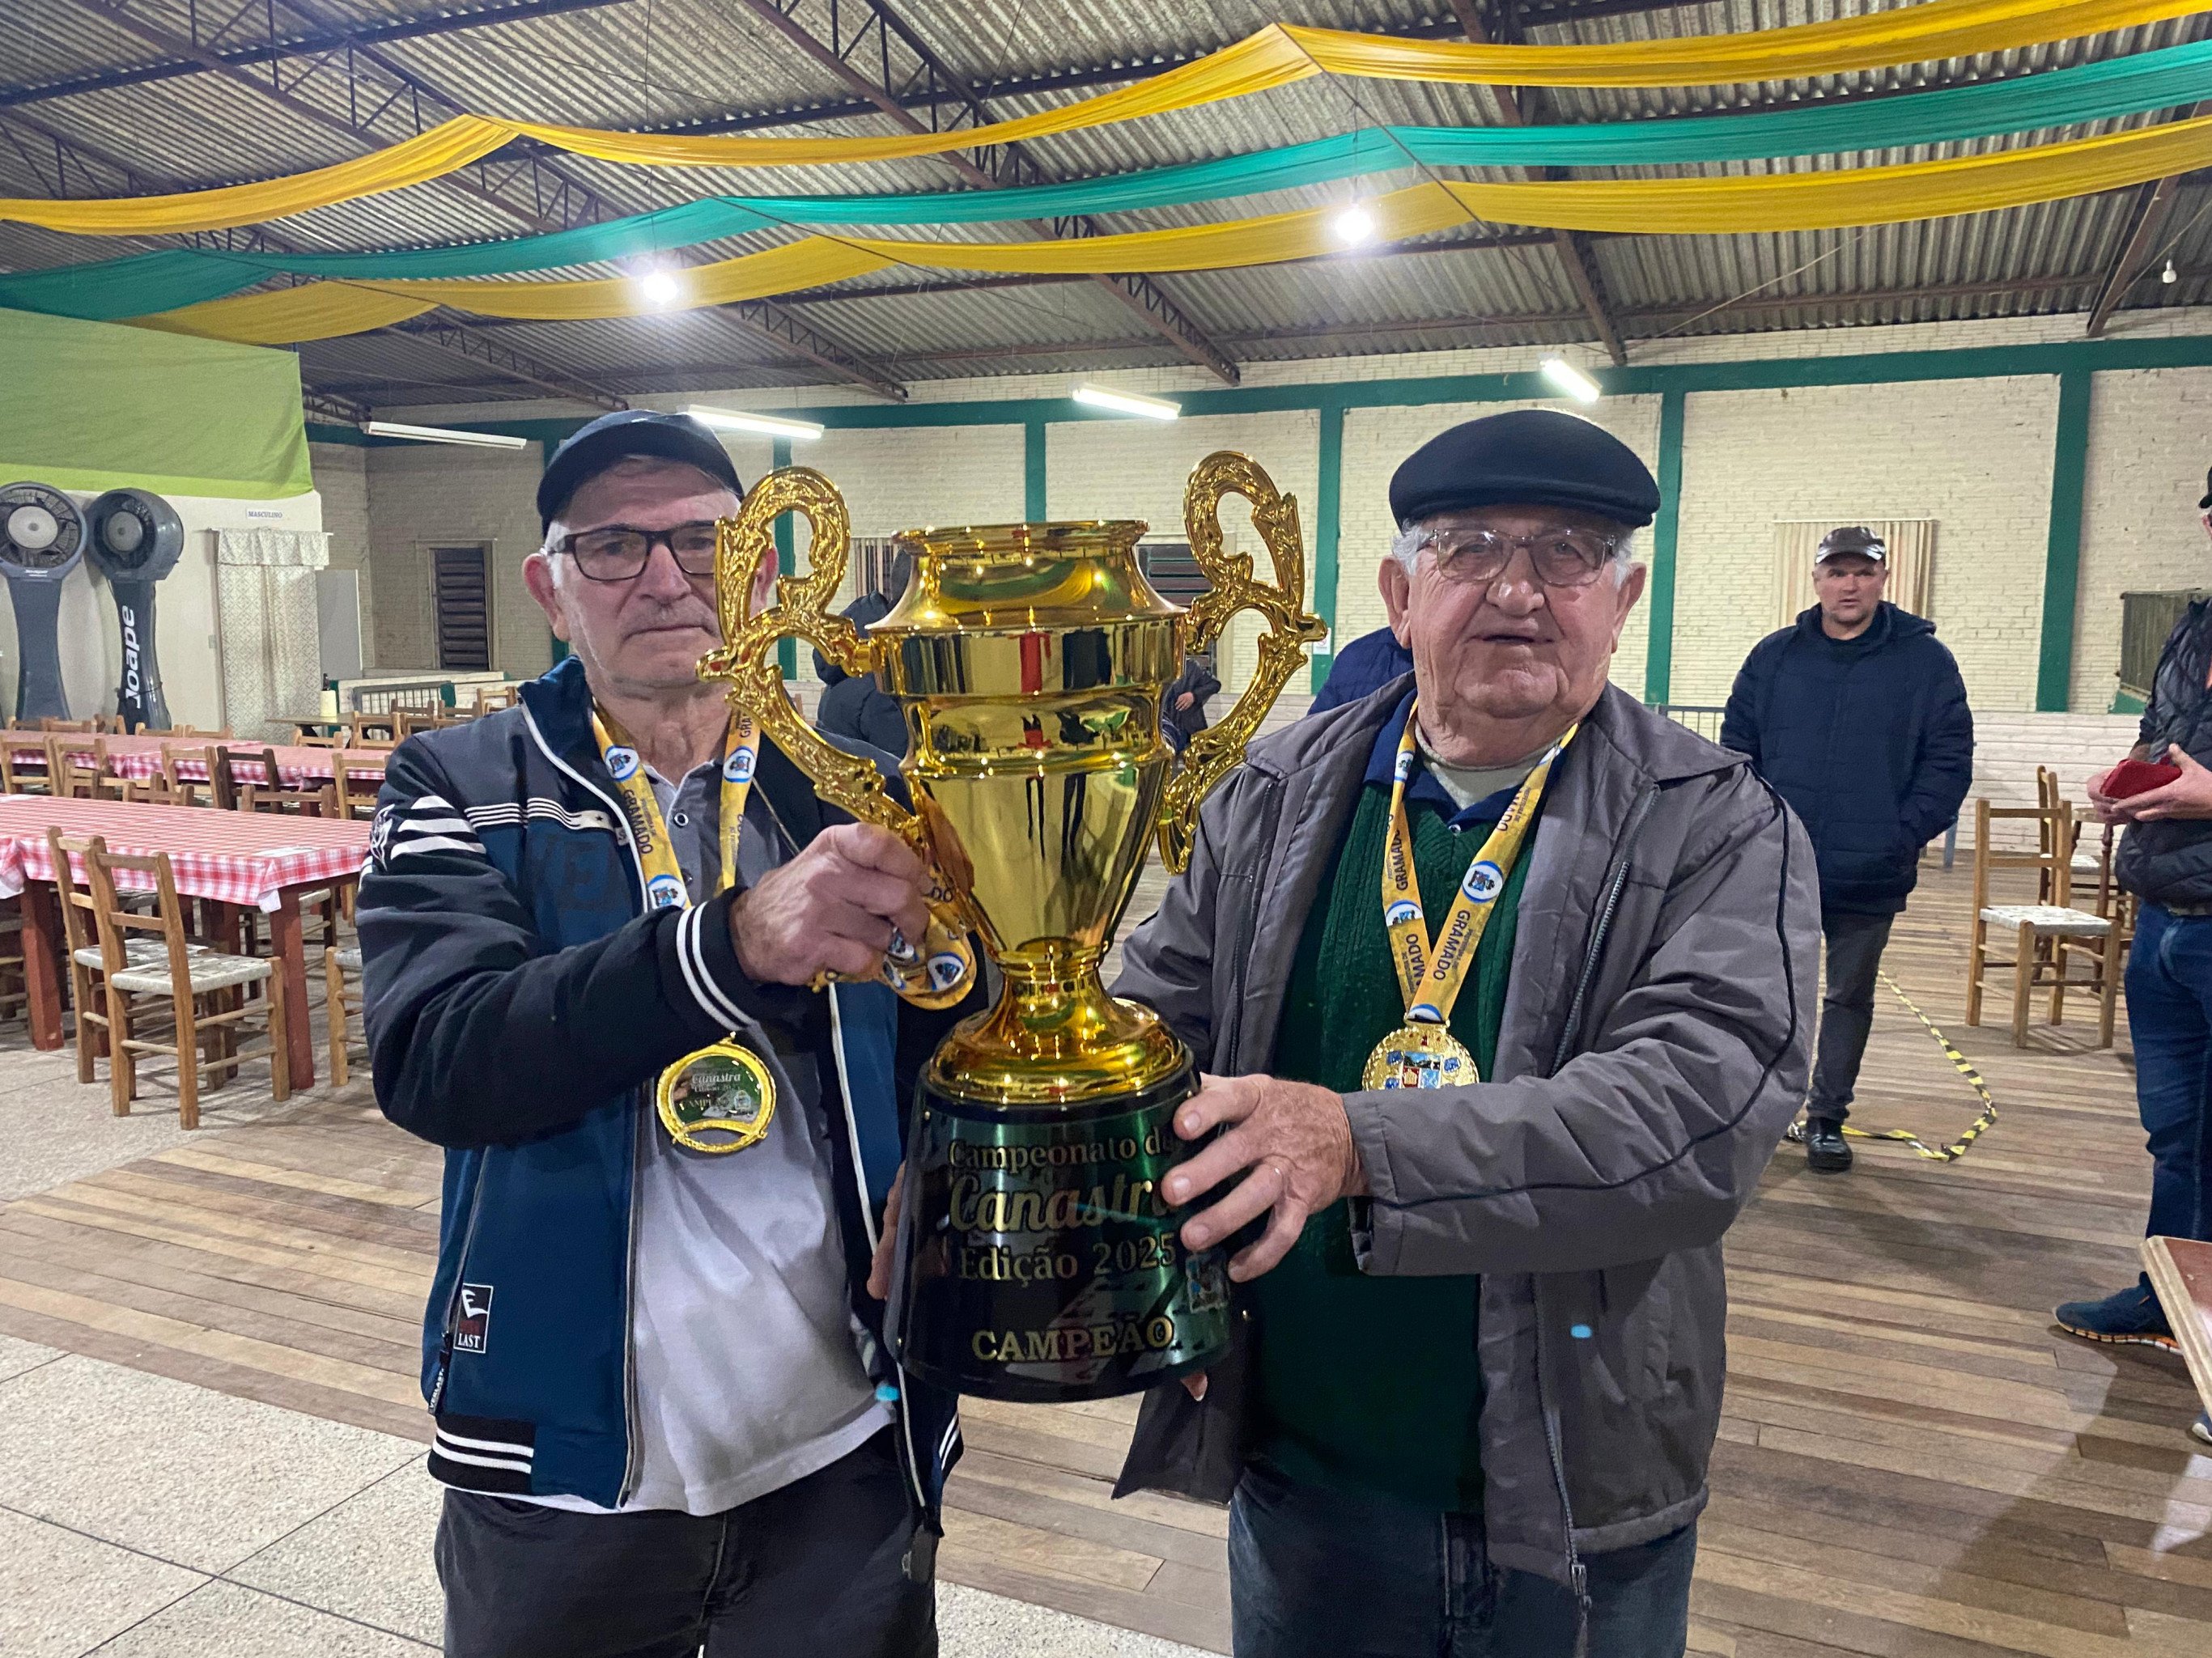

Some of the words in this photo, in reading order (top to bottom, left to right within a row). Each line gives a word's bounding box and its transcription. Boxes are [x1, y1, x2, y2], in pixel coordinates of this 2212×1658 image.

[624, 789, 653, 854] GRAMADO
[1433, 910, 1471, 981] GRAMADO
[949, 1137, 1137, 1173] Campeonato
[960, 1245, 1079, 1287] Edição
[1093, 1232, 1177, 1275] 2025
[457, 1333, 481, 1348] LAST
[971, 1313, 1174, 1362] CAMPEÃO
